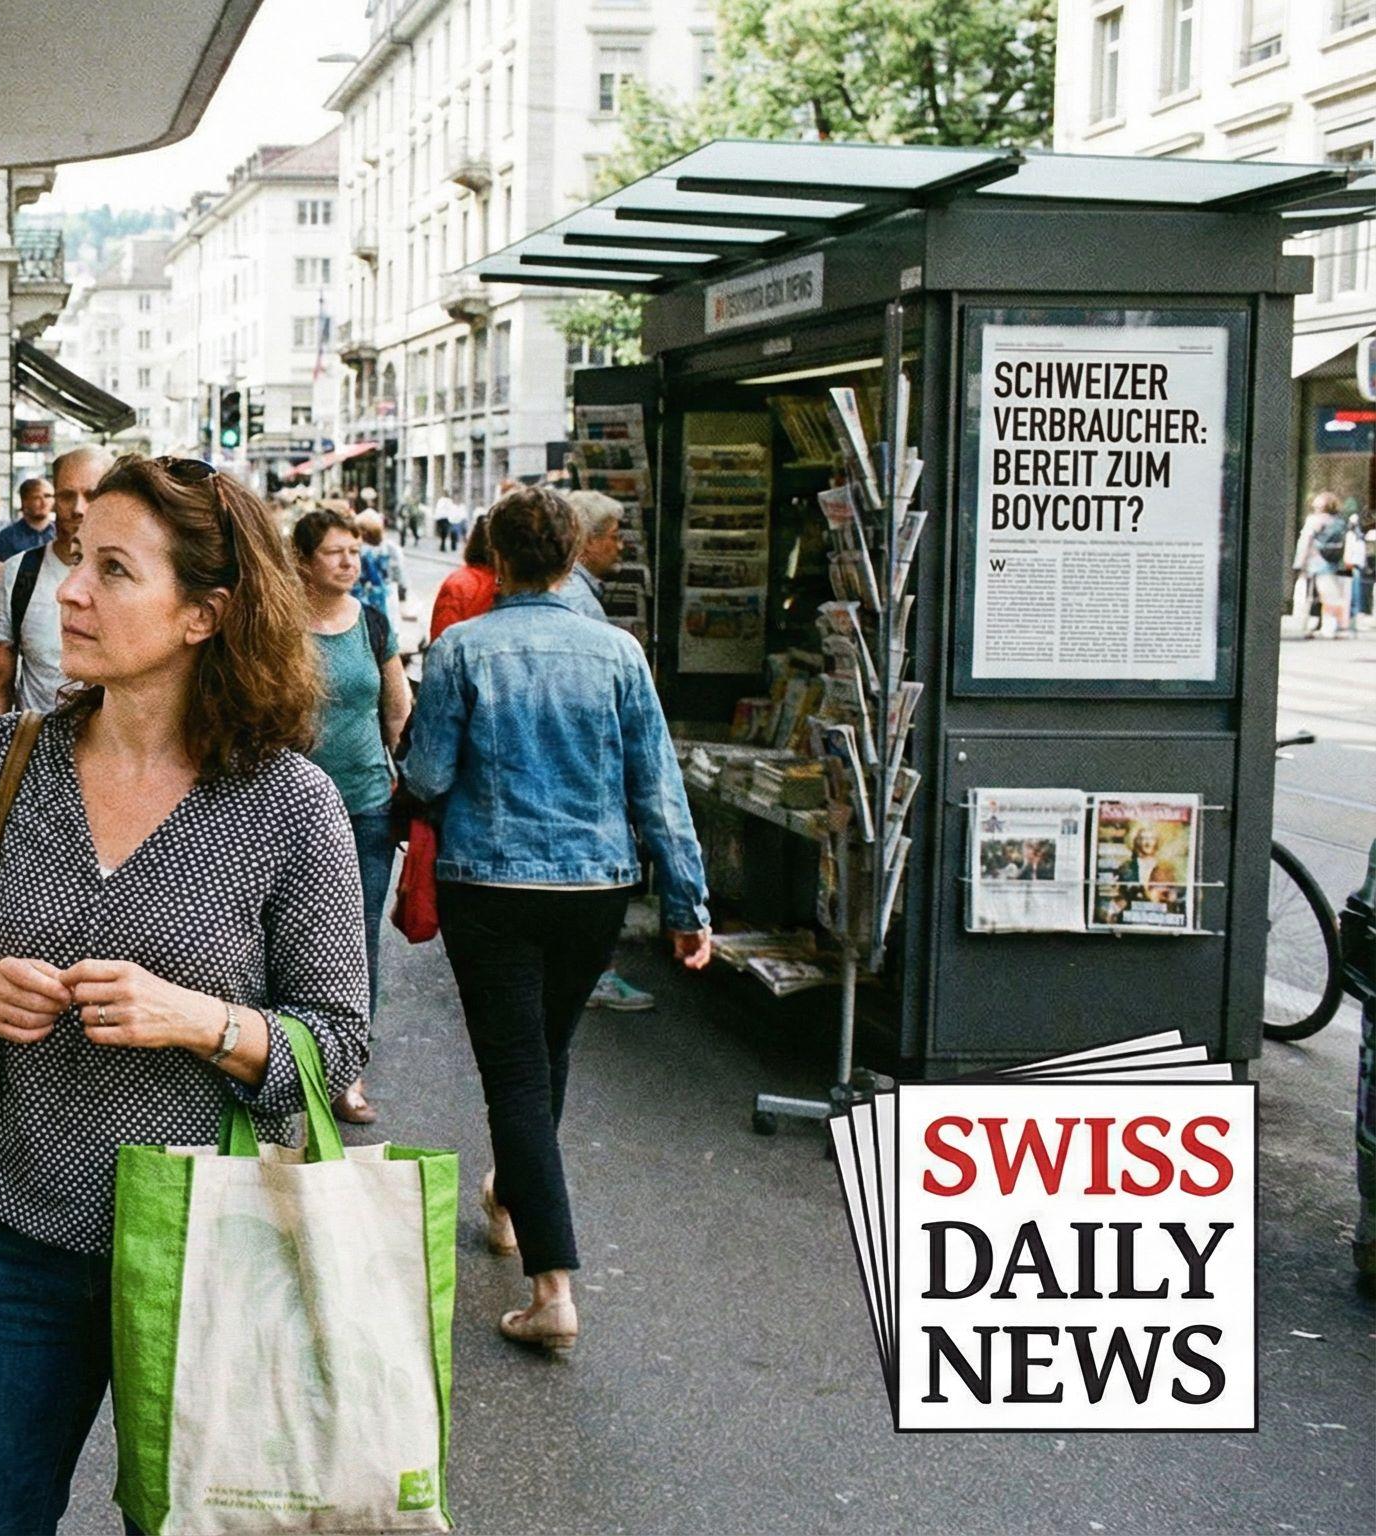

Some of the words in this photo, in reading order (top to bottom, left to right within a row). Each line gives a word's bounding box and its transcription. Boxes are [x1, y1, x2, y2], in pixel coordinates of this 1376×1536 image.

[994, 361, 1168, 401] SCHWEIZER
[993, 406, 1207, 444] VERBRAUCHER:
[993, 448, 1099, 488] BEREIT
[1105, 450, 1171, 489] ZUM
[991, 493, 1144, 533] BOYCOTT?
